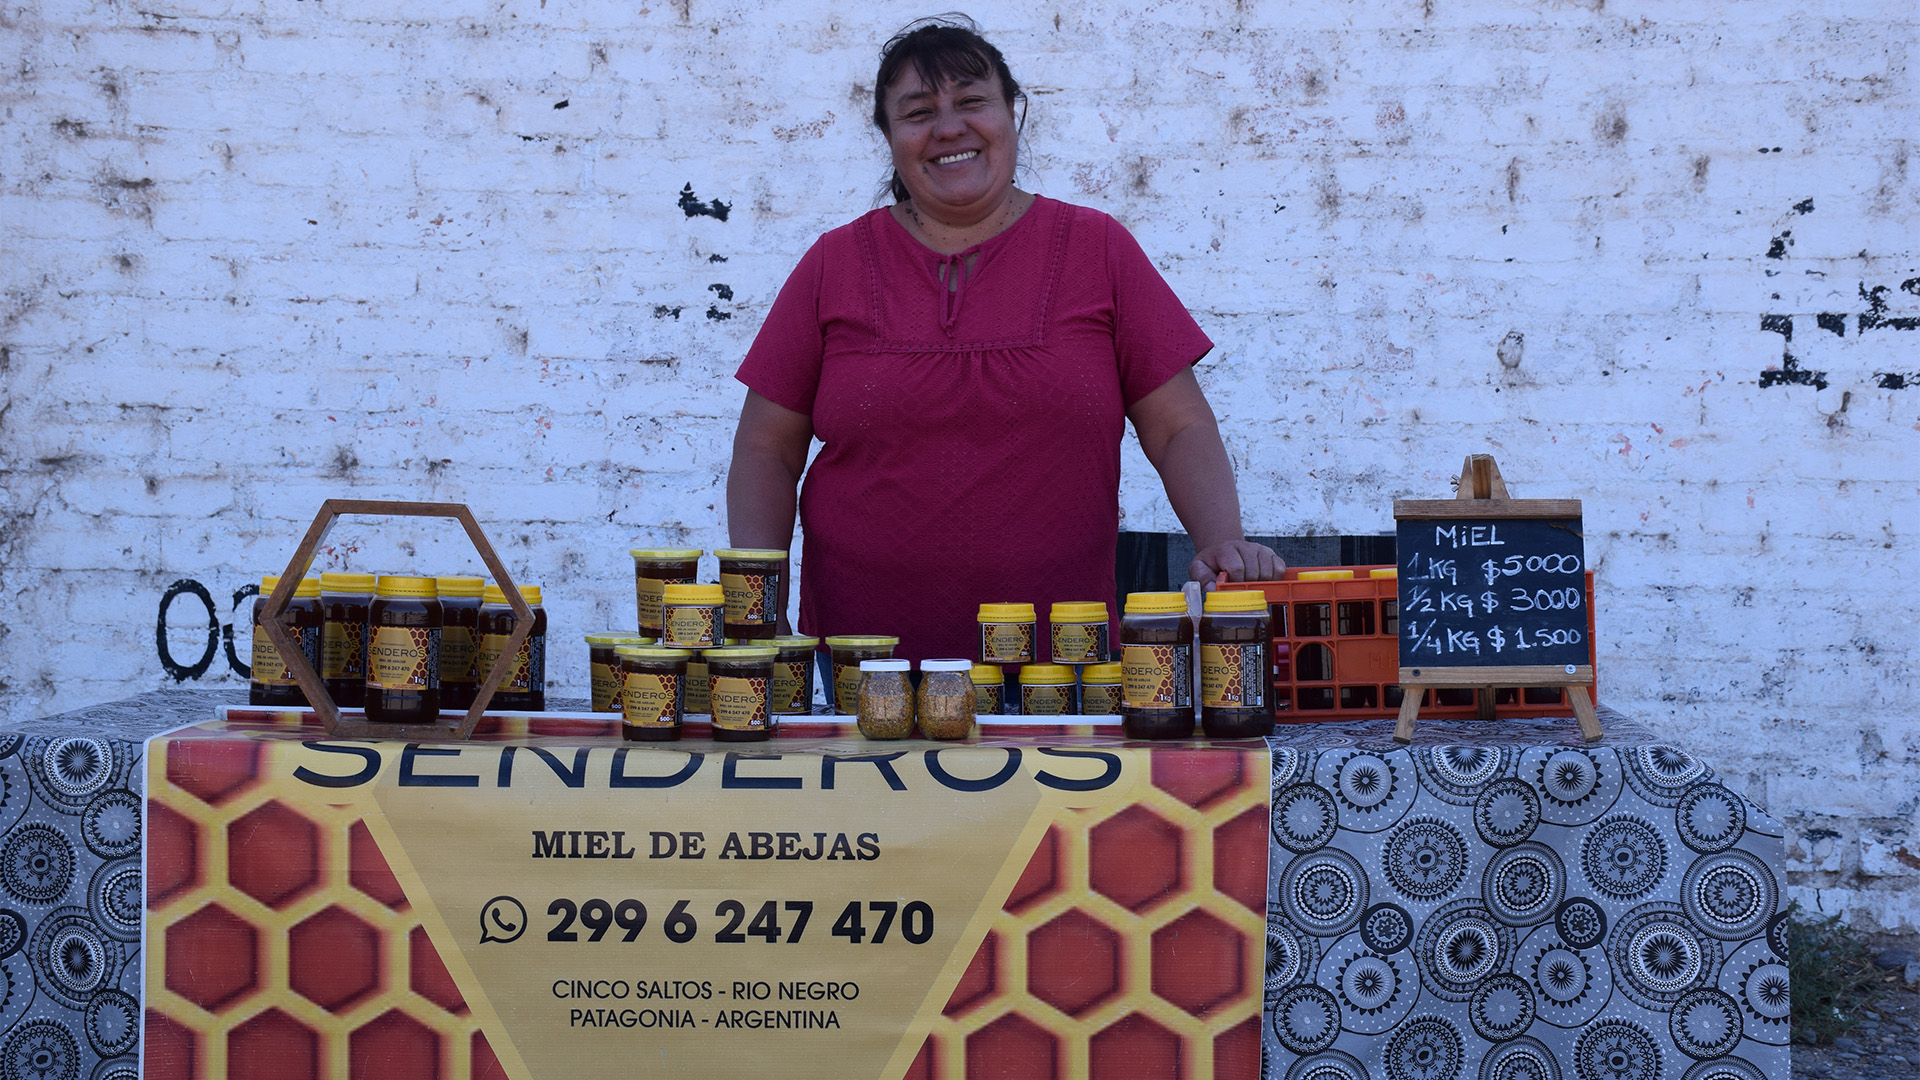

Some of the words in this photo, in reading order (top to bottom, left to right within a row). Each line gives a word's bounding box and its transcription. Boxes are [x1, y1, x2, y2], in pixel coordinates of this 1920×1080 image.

[293, 740, 1122, 792] SENDEROS
[531, 830, 636, 859] MIEL
[648, 831, 707, 860] DE
[718, 832, 881, 861] ABEJAS
[546, 898, 648, 943] 299
[663, 899, 698, 944] 6
[714, 899, 814, 944] 247
[831, 900, 934, 945] 470
[552, 979, 630, 1000] CINCO
[636, 980, 713, 1000] SALTOS
[732, 981, 772, 1001] RIO
[778, 981, 860, 1001] NEGRO
[570, 1008, 697, 1029] PATAGONIA
[714, 1009, 841, 1029] ARGENTINA
